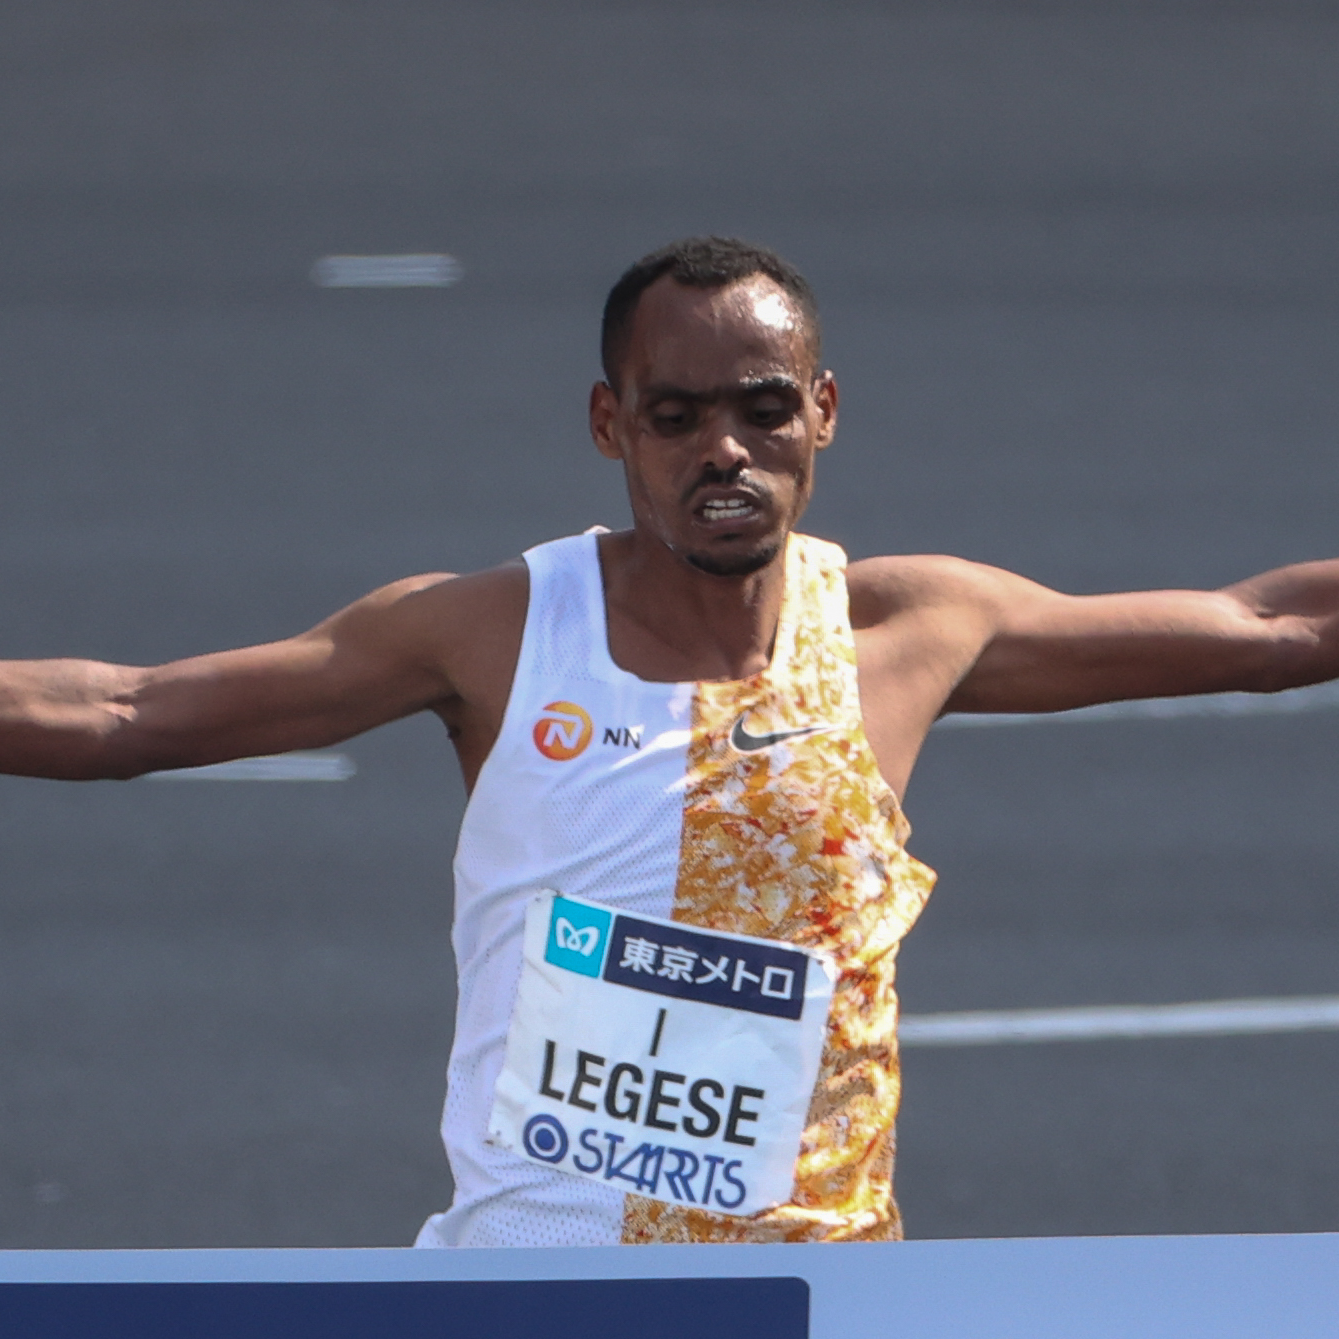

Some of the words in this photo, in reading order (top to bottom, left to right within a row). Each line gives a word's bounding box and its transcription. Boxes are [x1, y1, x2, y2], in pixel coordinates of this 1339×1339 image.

[618, 936, 796, 1000] 東京メトロ
[539, 1038, 766, 1147] LEGESE
